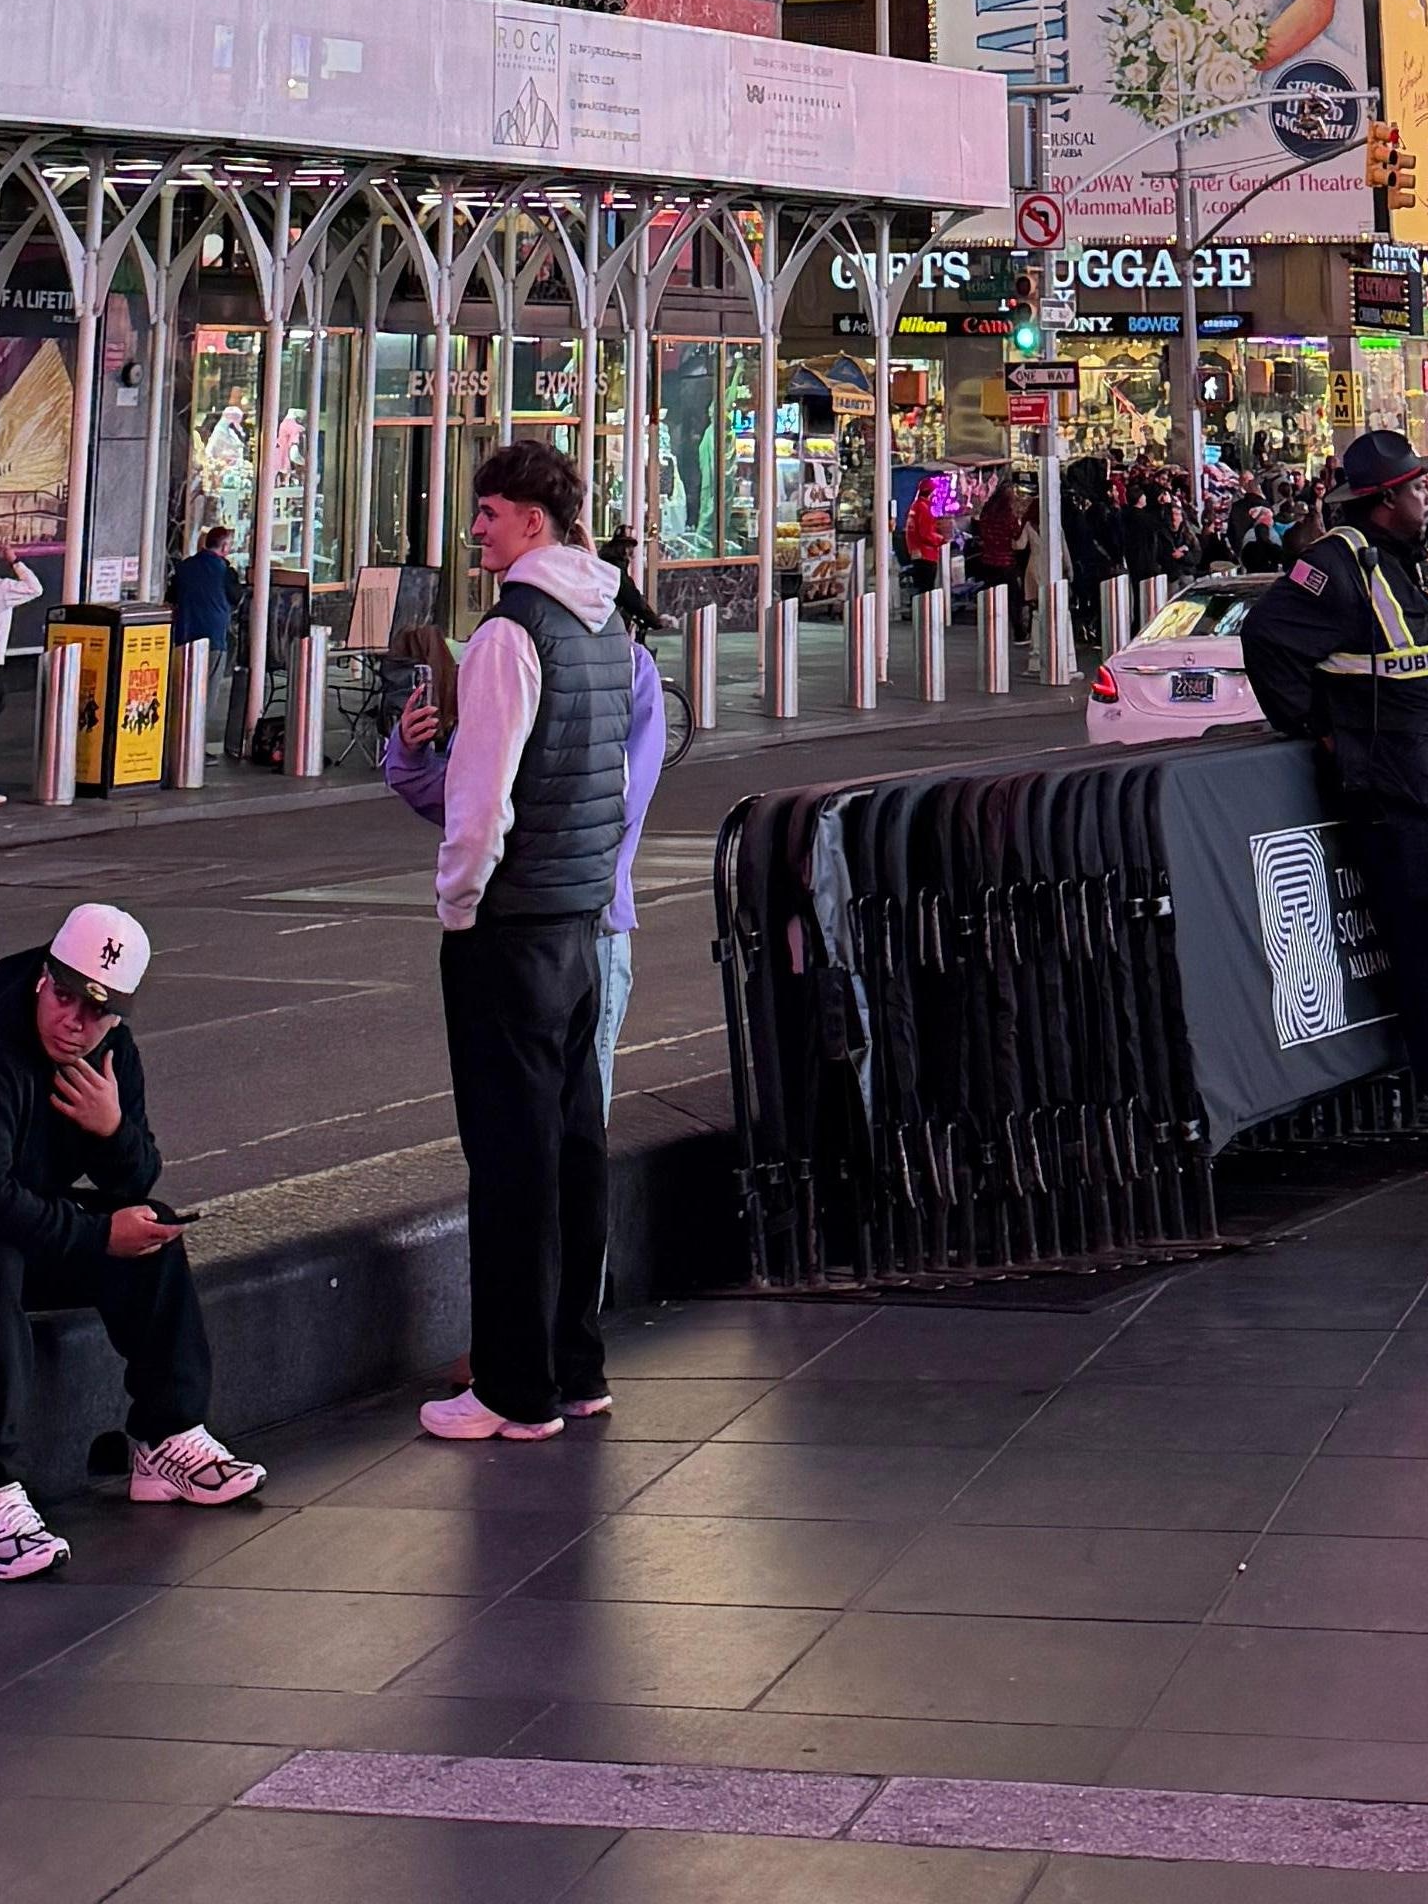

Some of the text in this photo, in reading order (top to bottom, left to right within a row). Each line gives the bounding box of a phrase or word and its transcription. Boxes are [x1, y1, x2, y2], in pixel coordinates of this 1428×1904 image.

[496, 26, 557, 56] ROCK
[1059, 147, 1083, 159] ABBA
[1050, 174, 1135, 193] ROADWAY
[1296, 173, 1364, 191] Theatre
[1052, 247, 1252, 290] UGGAGE
[13, 290, 23, 308] A
[898, 316, 948, 334] Nikon
[963, 316, 1014, 334] Cano
[1128, 315, 1182, 333] BOWER
[409, 370, 490, 396] EXRESS
[1016, 370, 1070, 383] ONE WAY
[1334, 373, 1350, 419] ATM
[1336, 907, 1377, 947] SQUA
